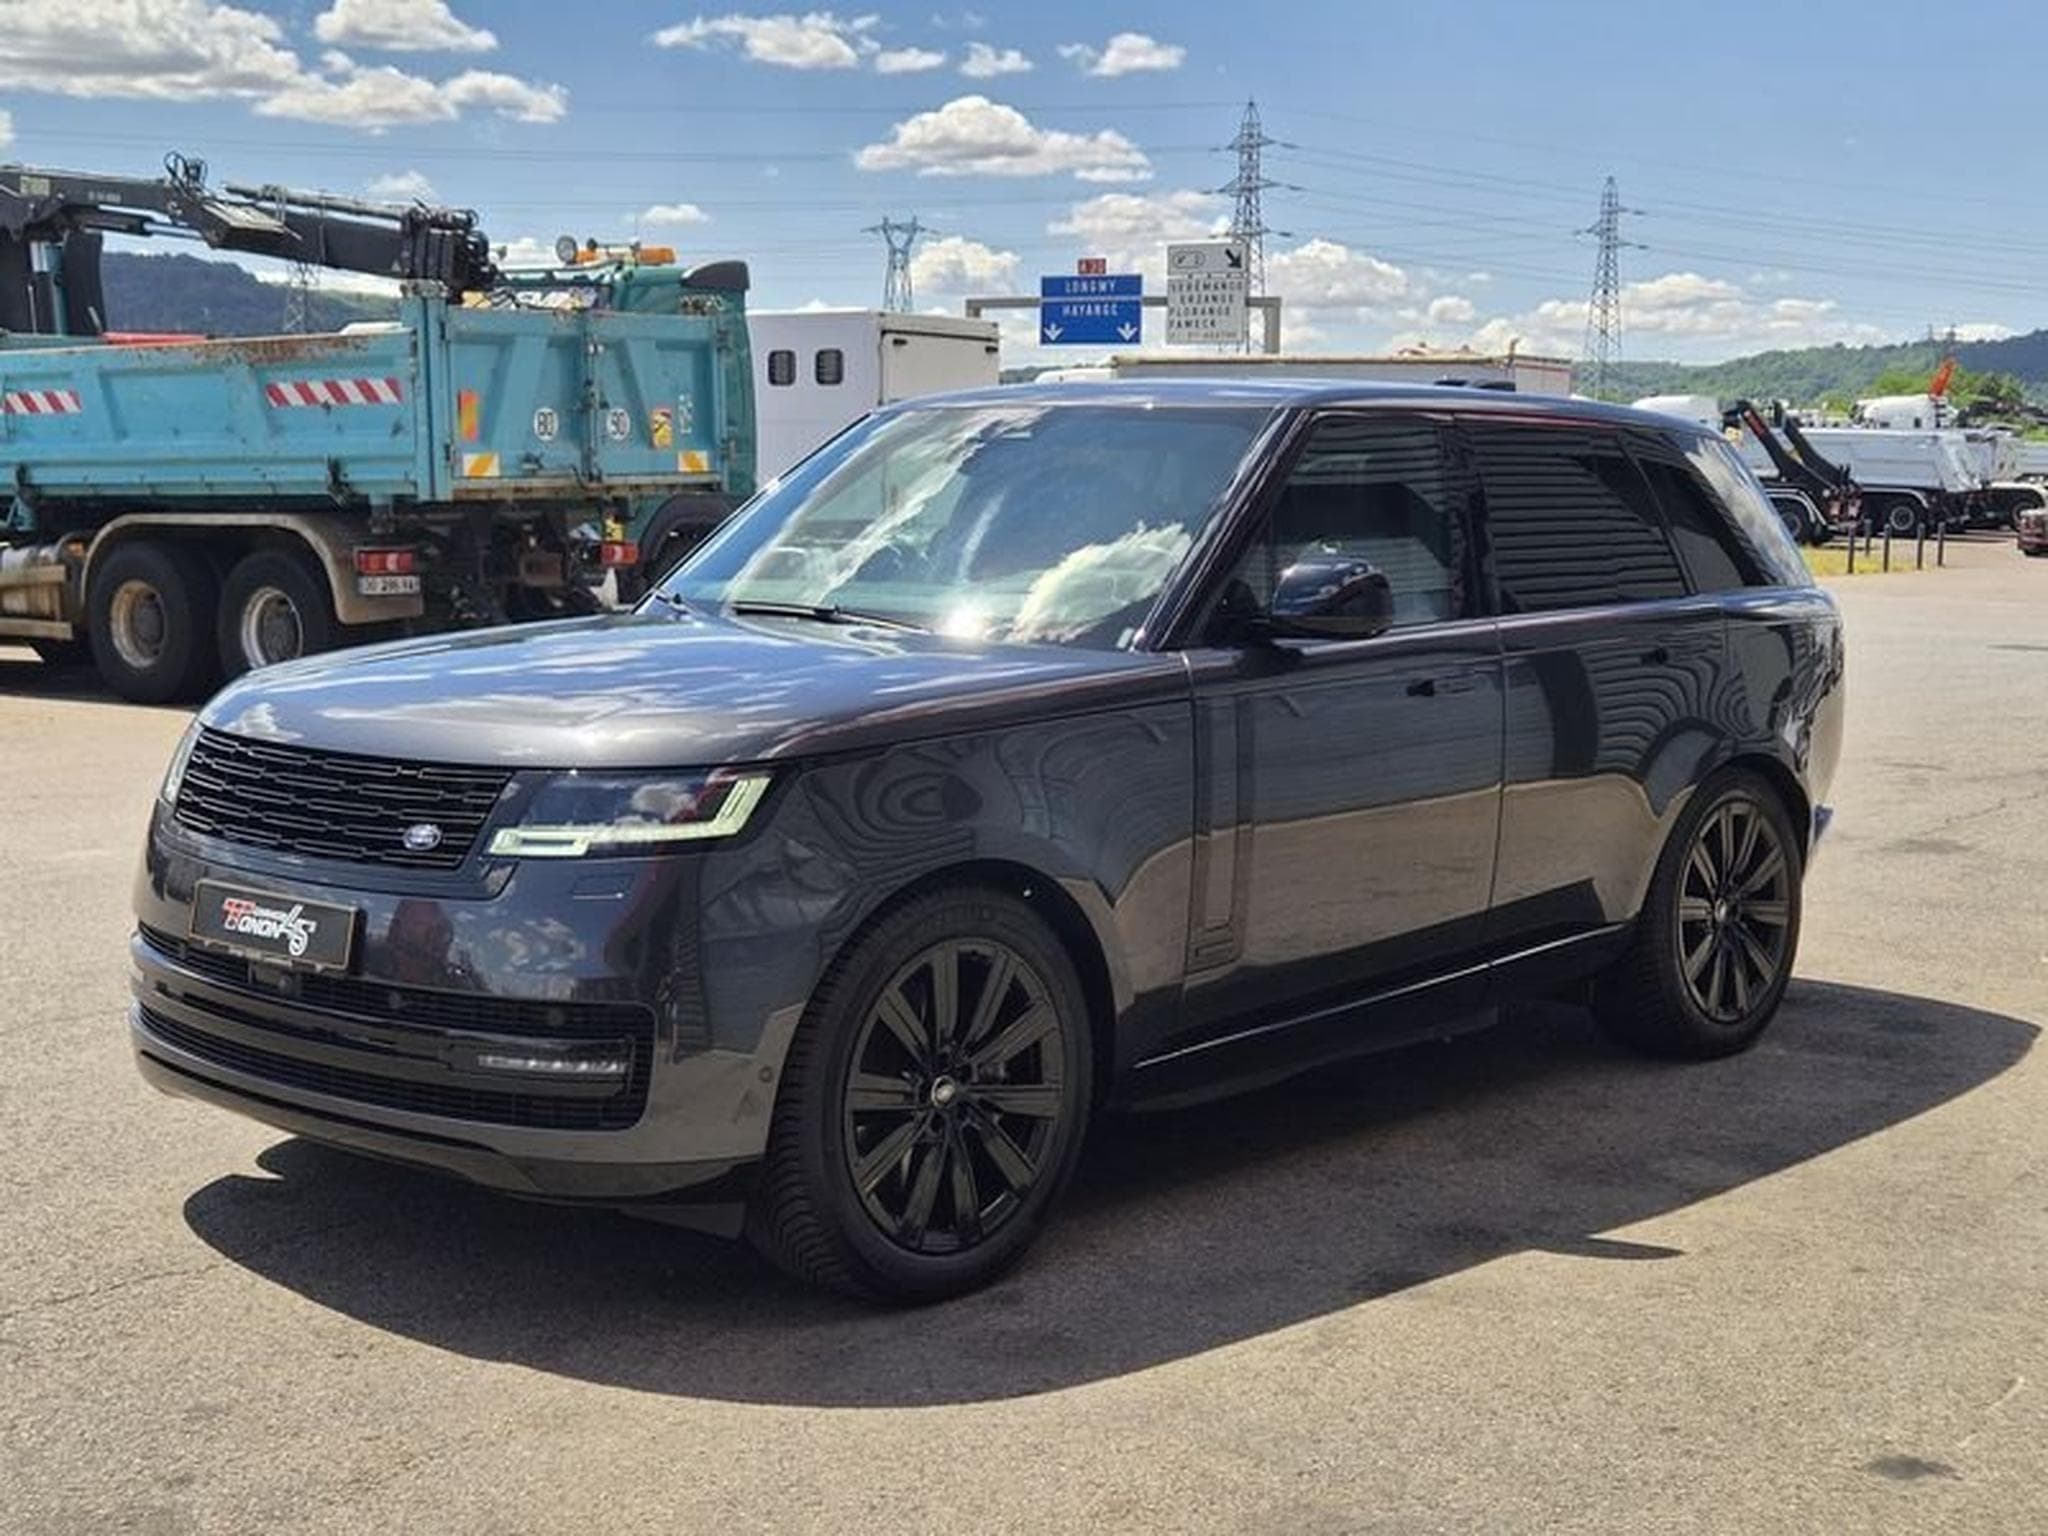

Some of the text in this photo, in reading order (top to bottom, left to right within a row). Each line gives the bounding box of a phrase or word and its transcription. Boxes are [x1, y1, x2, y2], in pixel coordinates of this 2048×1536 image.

[1064, 279, 1117, 294] LONGWY
[1062, 303, 1118, 317] HAYANGE
[1169, 306, 1230, 318] FLORANGE
[1169, 318, 1216, 329] FAMECK
